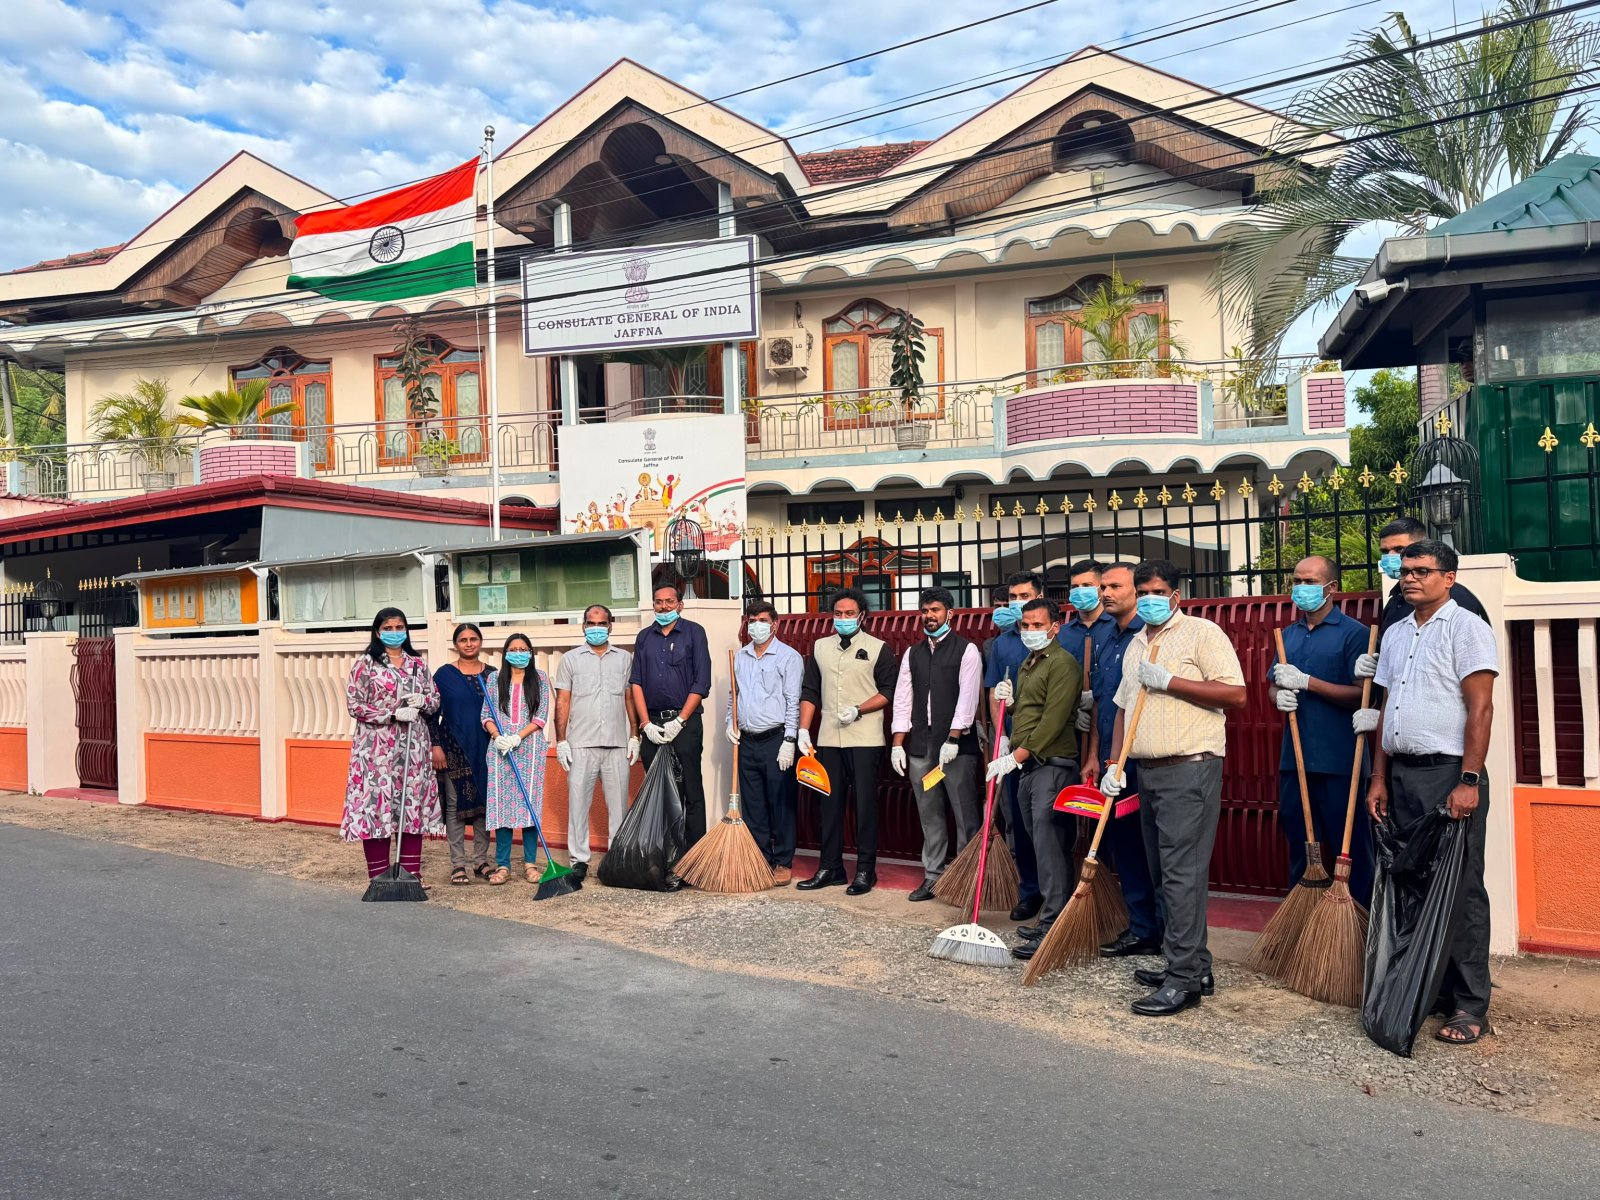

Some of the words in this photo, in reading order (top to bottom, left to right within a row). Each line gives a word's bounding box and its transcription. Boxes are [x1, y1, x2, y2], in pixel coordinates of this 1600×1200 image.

[537, 316, 613, 331] CONSULATE
[617, 310, 678, 324] GENERAL
[682, 308, 700, 319] OF
[704, 304, 741, 317] INDIA
[614, 326, 663, 340] JAFFNA
